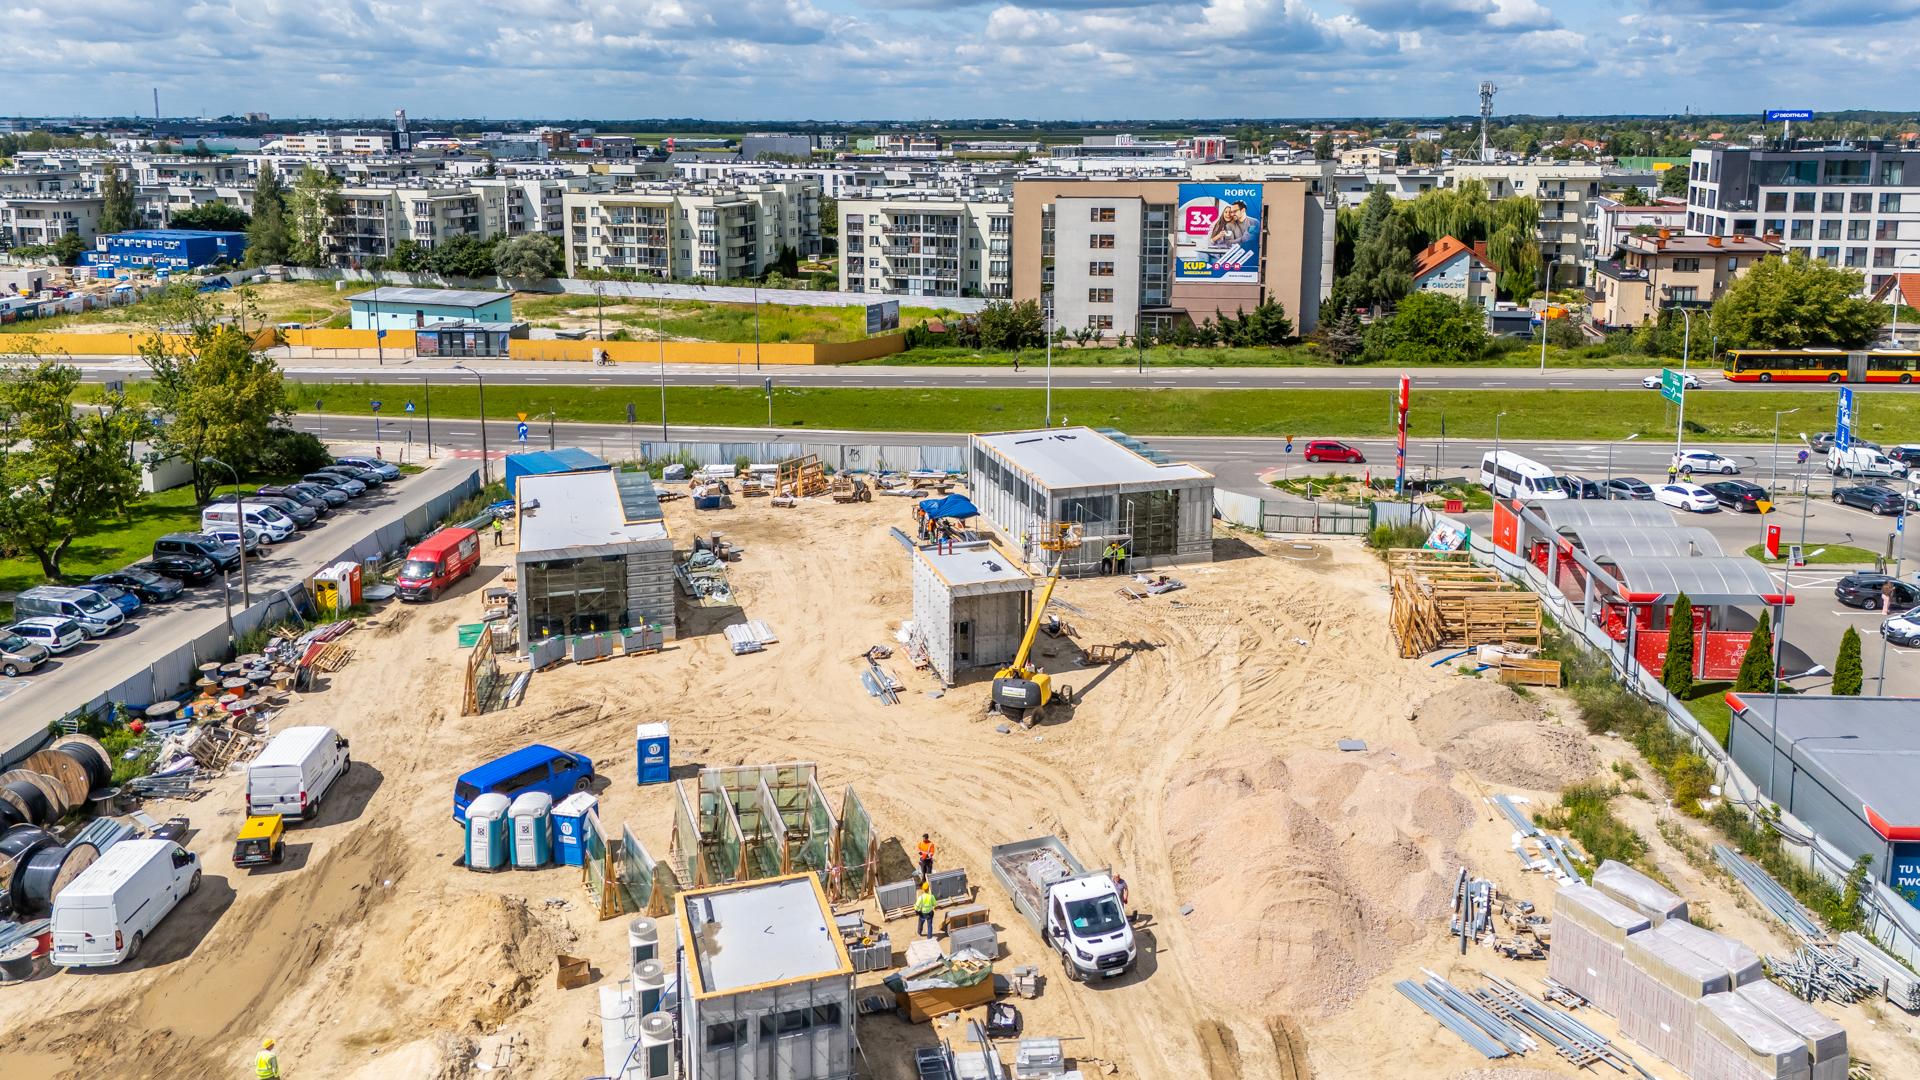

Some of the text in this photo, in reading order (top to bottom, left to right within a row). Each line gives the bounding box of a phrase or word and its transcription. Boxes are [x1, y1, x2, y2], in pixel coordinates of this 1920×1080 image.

[1224, 189, 1256, 197] ROBYG
[1190, 211, 1213, 225] 3x
[1184, 262, 1206, 270] KUP
[1899, 865, 1913, 873] TU
